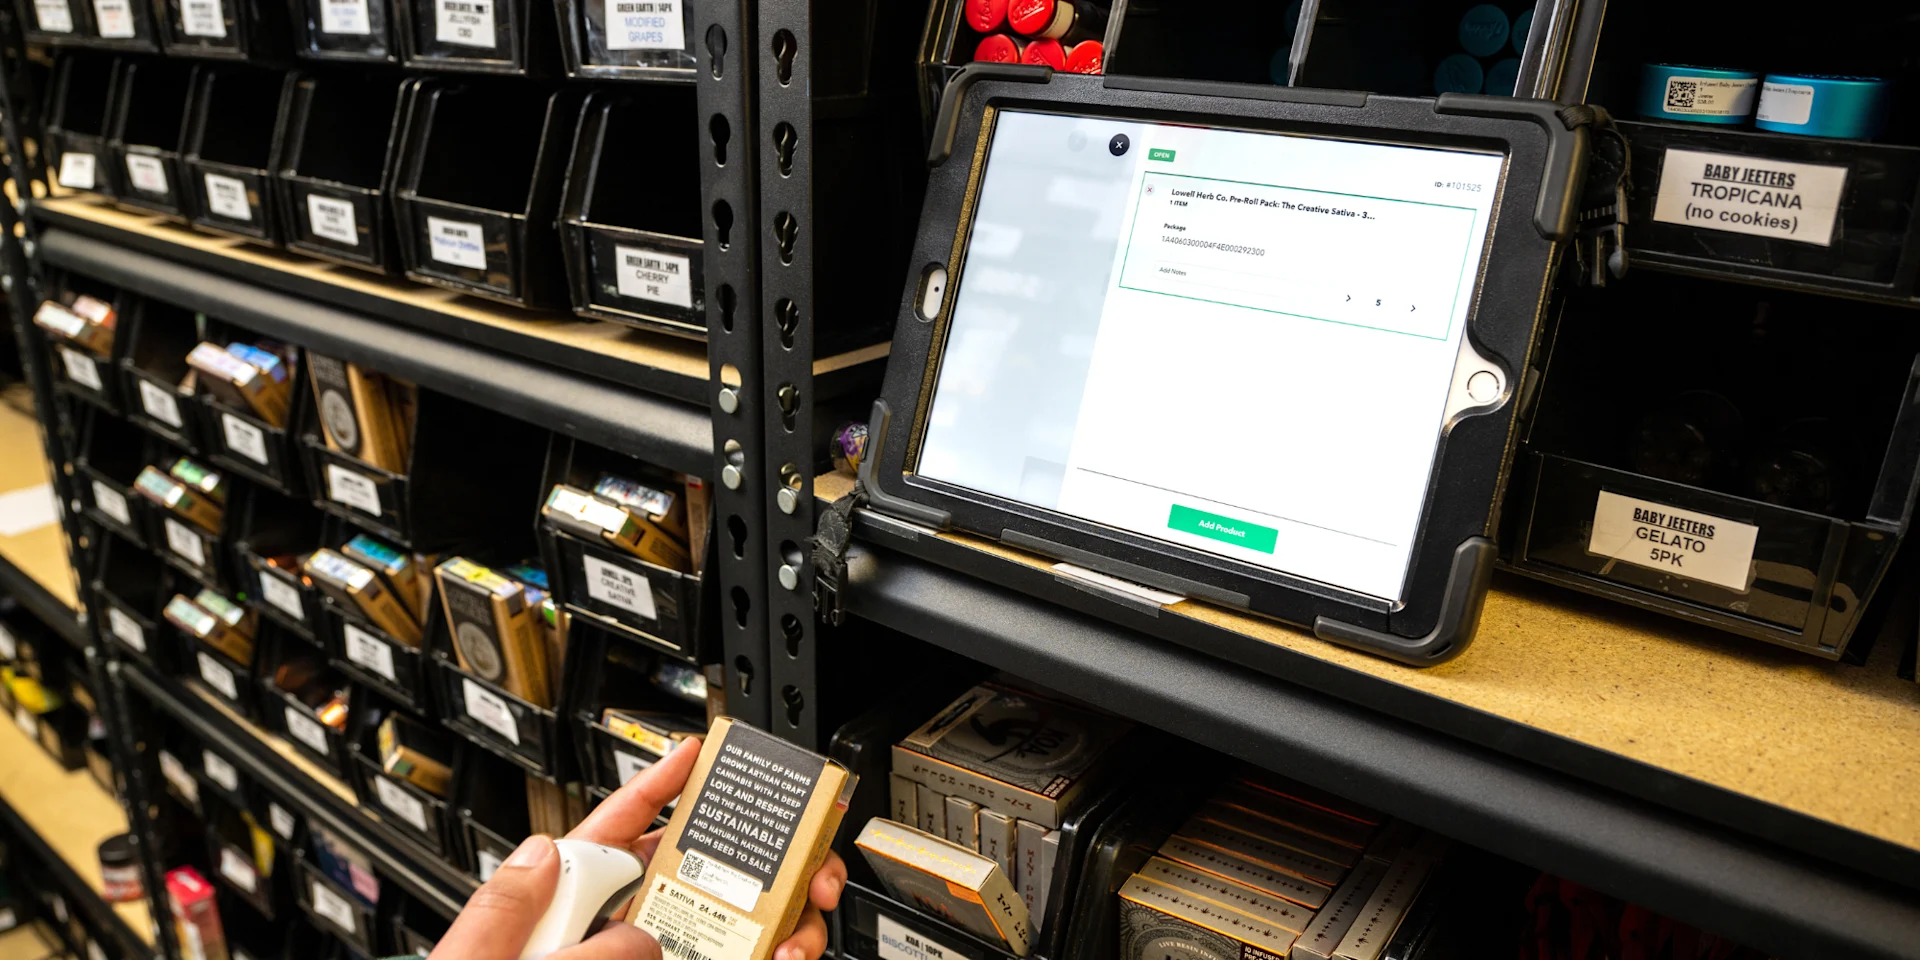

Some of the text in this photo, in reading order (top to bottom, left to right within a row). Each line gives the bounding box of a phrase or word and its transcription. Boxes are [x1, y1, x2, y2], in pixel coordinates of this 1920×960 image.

[624, 17, 665, 27] MODIFIED
[628, 31, 663, 42] GRAPES
[1446, 182, 1482, 192] #101525
[1704, 164, 1796, 188] BABY JEETERS
[1172, 188, 1195, 198] Lowell
[1196, 192, 1214, 200] Herb
[1216, 194, 1228, 202] Co.
[1229, 196, 1258, 205] Pre-Roll
[1260, 199, 1280, 208] Pack:
[1282, 202, 1296, 210] The
[1297, 203, 1330, 215] Creative
[1331, 207, 1355, 218] Sativa
[1691, 182, 1802, 210] TROPICANA
[1164, 223, 1186, 232] Package
[1686, 202, 1798, 234] (no cookies)
[636, 270, 668, 284] CHERRY
[1172, 268, 1187, 276] Notes
[647, 284, 660, 296] PIE
[1198, 520, 1246, 538] Add Product
[1633, 508, 1715, 537] BABY JEETERS
[1636, 526, 1705, 553] GELATO
[1650, 548, 1684, 567] 5PK
[601, 577, 636, 596] CREATIVE
[720, 755, 806, 798] GROWS ARTISAN CRAFT
[725, 744, 811, 786] OUR FAMILY OF FARMS
[710, 778, 796, 822] LOVE AND RESPECT
[715, 767, 802, 808] CANNABIS WITH A DEEP
[704, 791, 790, 834] FOR THE PLANT. WE USE
[1004, 797, 1032, 811] MINI
[698, 803, 785, 850] SUSTAINABLE
[687, 828, 713, 847] FROM
[713, 840, 735, 856] SEED
[736, 851, 748, 862] TO
[748, 856, 772, 875] SALE.
[692, 818, 779, 862] AND NATURAL MATERIALS
[669, 889, 695, 907] SATIVA
[699, 904, 727, 923] 24.44%
[882, 934, 928, 960] BISCOTTI
[905, 934, 920, 948] KOA
[925, 944, 943, 959] 10PK
[1176, 943, 1198, 952] RESIN
[1253, 949, 1280, 960] INFUSED
